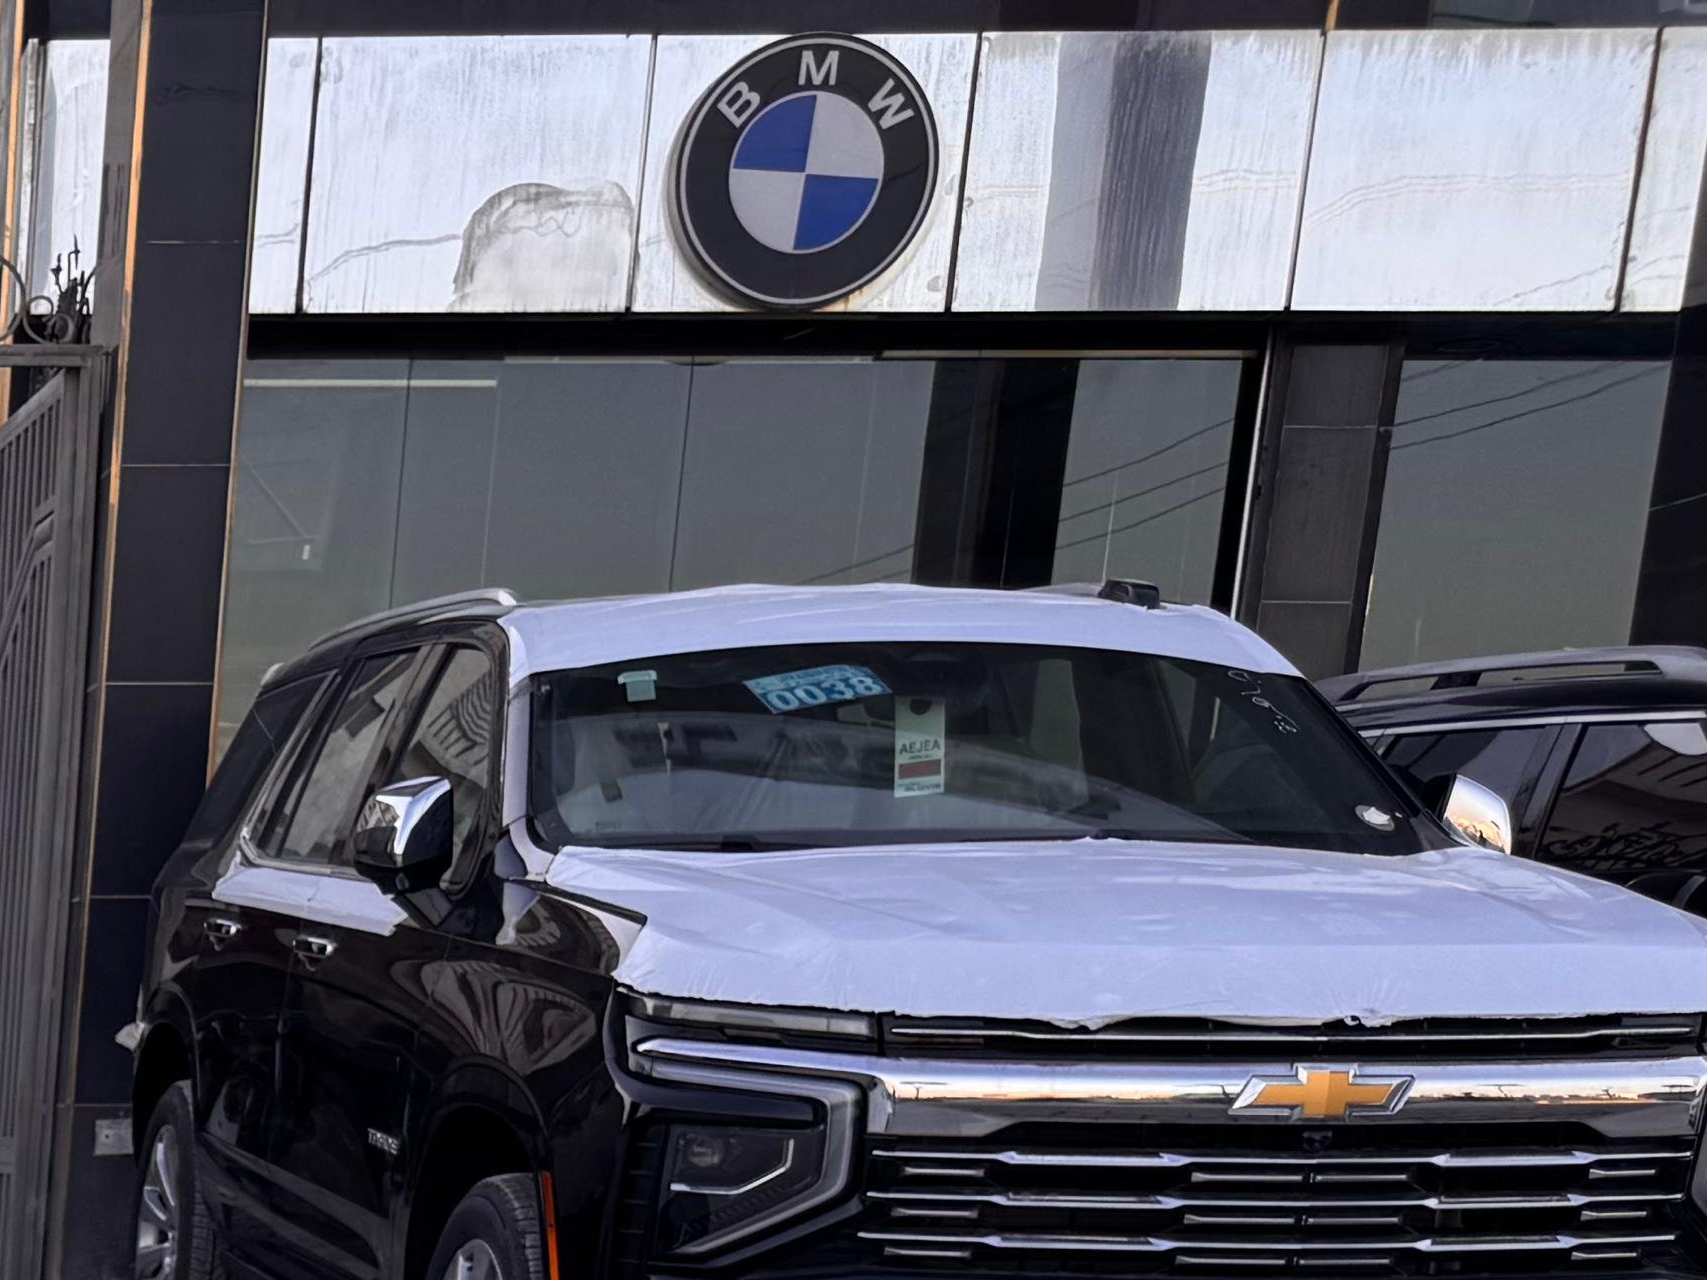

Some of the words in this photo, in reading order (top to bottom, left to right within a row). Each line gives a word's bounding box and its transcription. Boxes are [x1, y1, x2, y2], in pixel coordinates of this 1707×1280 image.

[716, 49, 915, 130] BMW
[766, 676, 884, 711] 0038
[899, 739, 941, 755] AEJEA
